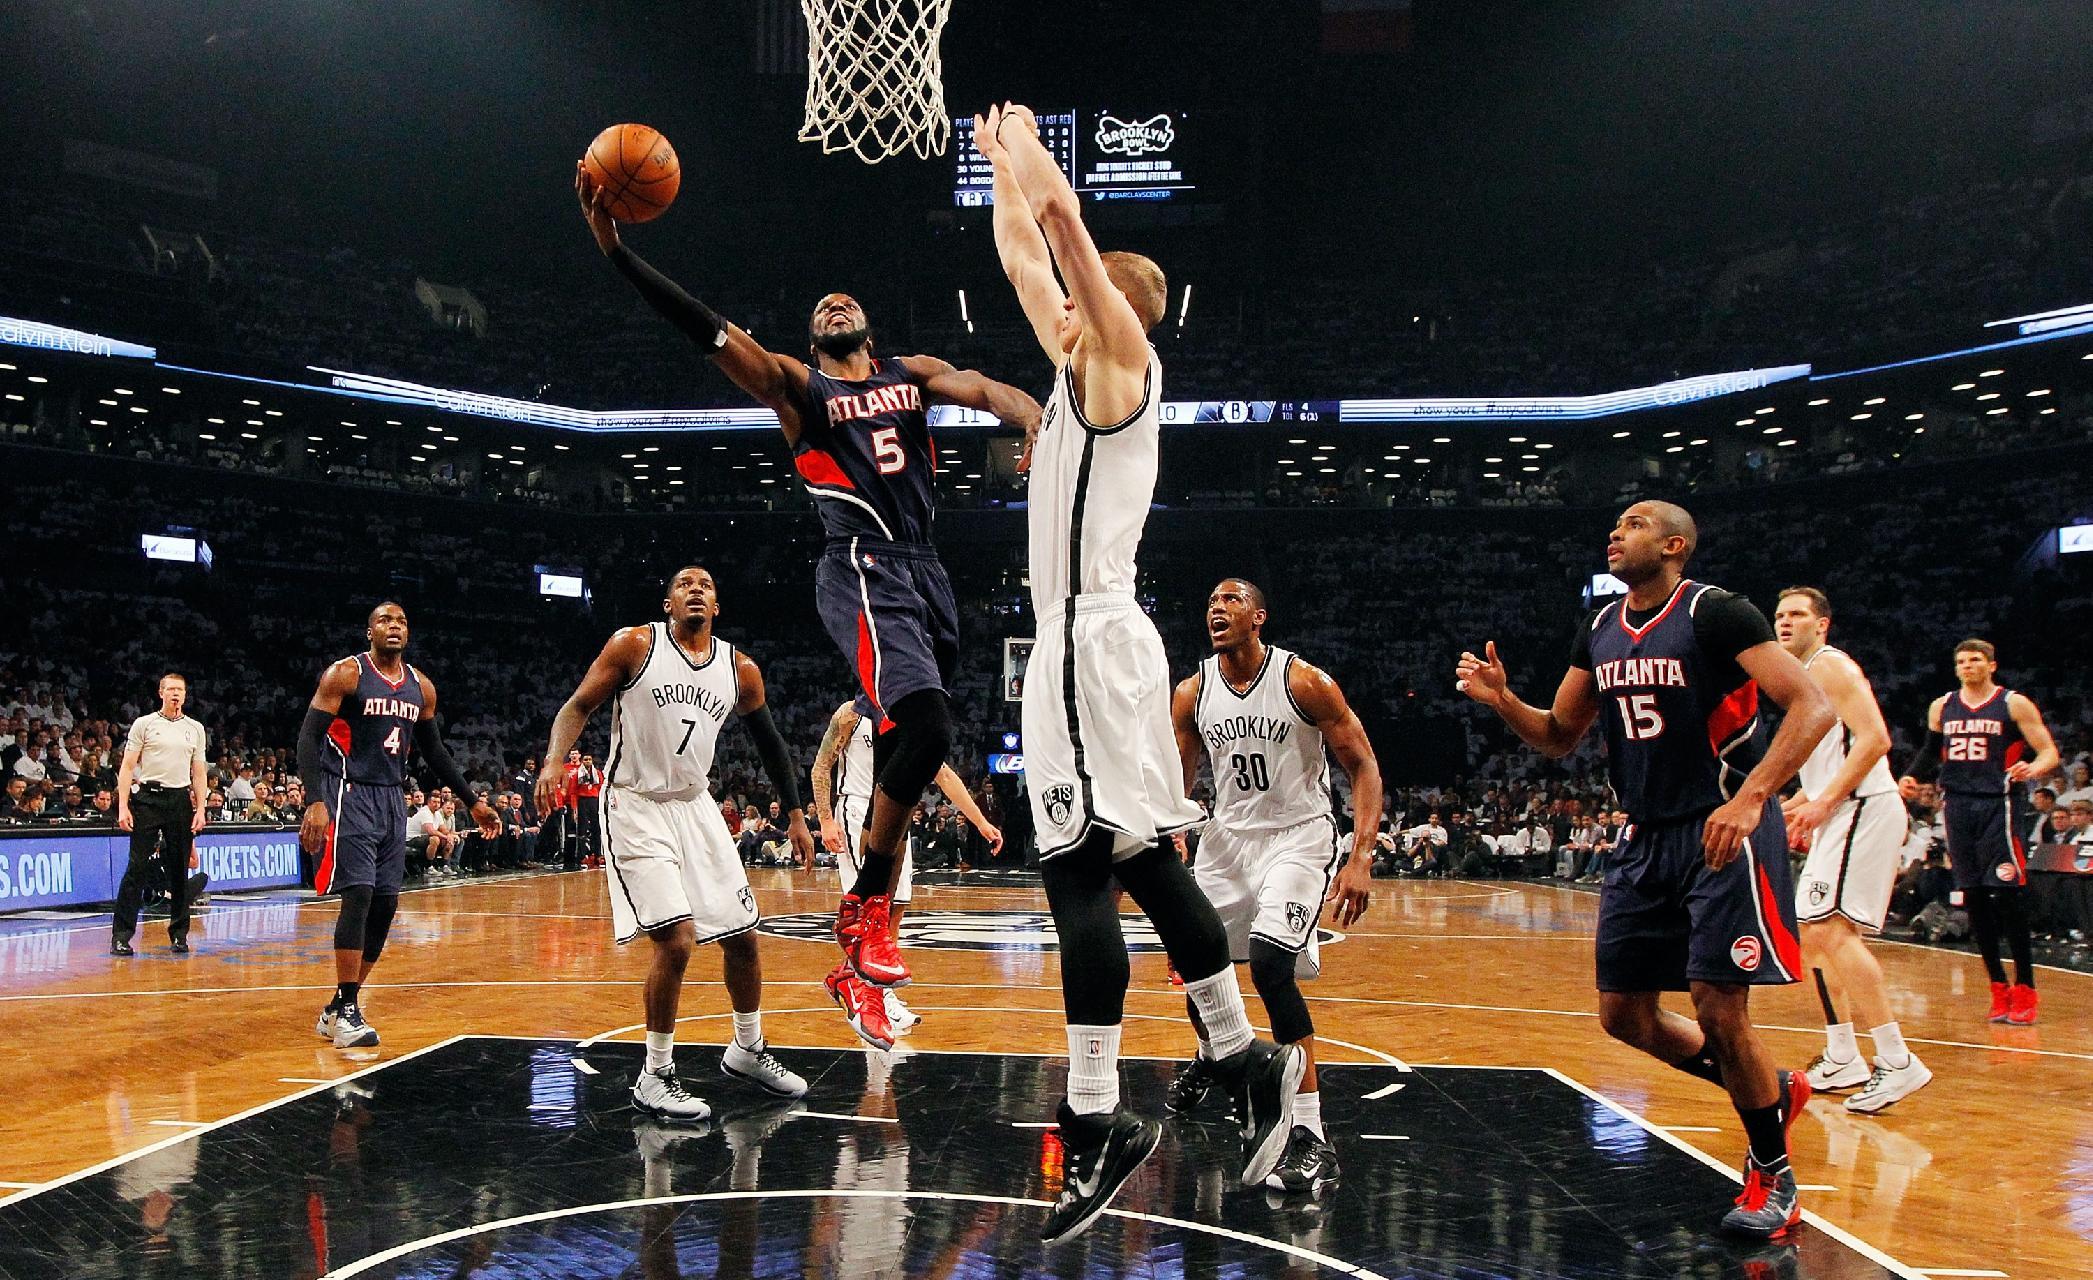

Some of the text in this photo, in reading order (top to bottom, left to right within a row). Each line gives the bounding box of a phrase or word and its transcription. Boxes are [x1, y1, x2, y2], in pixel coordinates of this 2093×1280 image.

[955, 117, 974, 127] PLAYE
[958, 131, 964, 139] 1
[1048, 140, 1055, 148] 2
[1102, 127, 1168, 145] BROOKLYN
[1122, 139, 1150, 148] BOWL
[957, 165, 967, 173] 30
[1108, 190, 1171, 199] @BARCLAYSCENTER
[60, 328, 111, 358] Klein
[825, 384, 924, 429] ATLANTA
[958, 409, 980, 424] 11
[1231, 403, 1241, 420] B
[1301, 402, 1309, 411] 4
[872, 427, 906, 474] 5
[1594, 658, 1688, 692] ATLANTA
[363, 698, 420, 723] ATLANTA
[651, 683, 727, 722] BROOKLYN
[1616, 694, 1664, 740] 15
[1943, 719, 2002, 736] ATLANTA
[383, 726, 401, 755] 4
[675, 718, 696, 756] 7
[1206, 715, 1292, 749] BROOKLYN
[1948, 737, 1988, 761] 26
[1231, 753, 1270, 792] 30
[1043, 784, 1072, 809] NETS
[187, 843, 298, 882] TICKETS.COM
